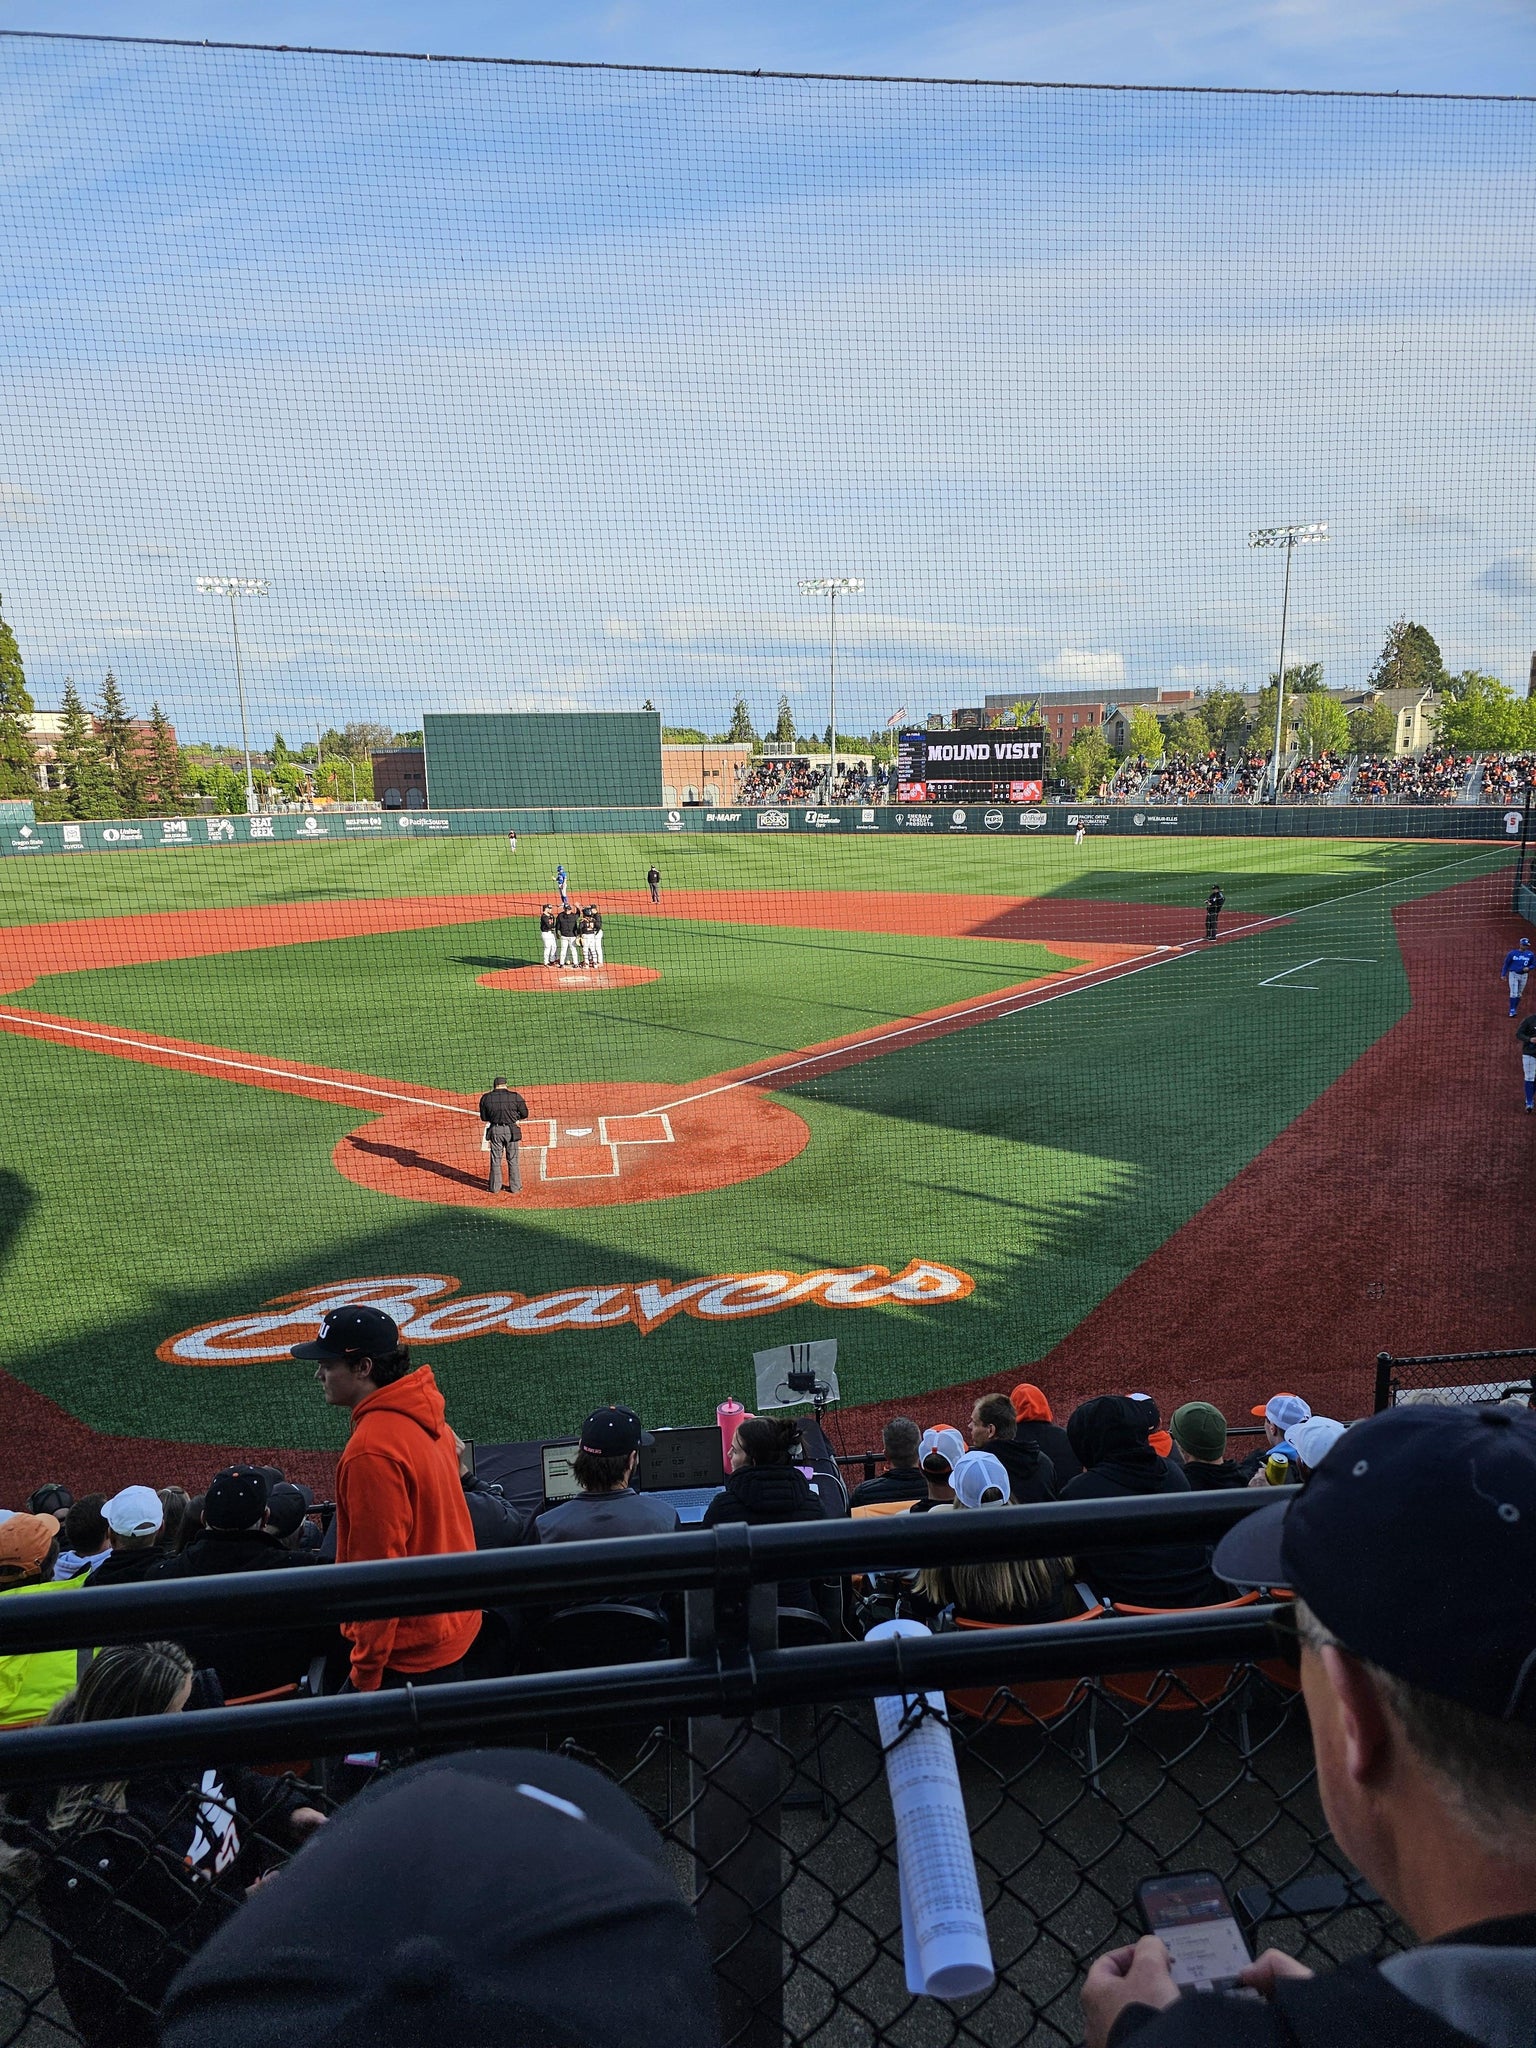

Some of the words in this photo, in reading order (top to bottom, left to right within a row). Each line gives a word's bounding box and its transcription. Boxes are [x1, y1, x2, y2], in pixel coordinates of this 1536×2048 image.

[928, 744, 990, 761] MOUND
[994, 742, 1042, 759] VISIT
[250, 817, 272, 827] SEAT
[706, 813, 741, 821] BI-MART
[1510, 817, 1516, 826] 5
[250, 827, 274, 837] GEEK
[155, 1257, 976, 1367] Beavers
